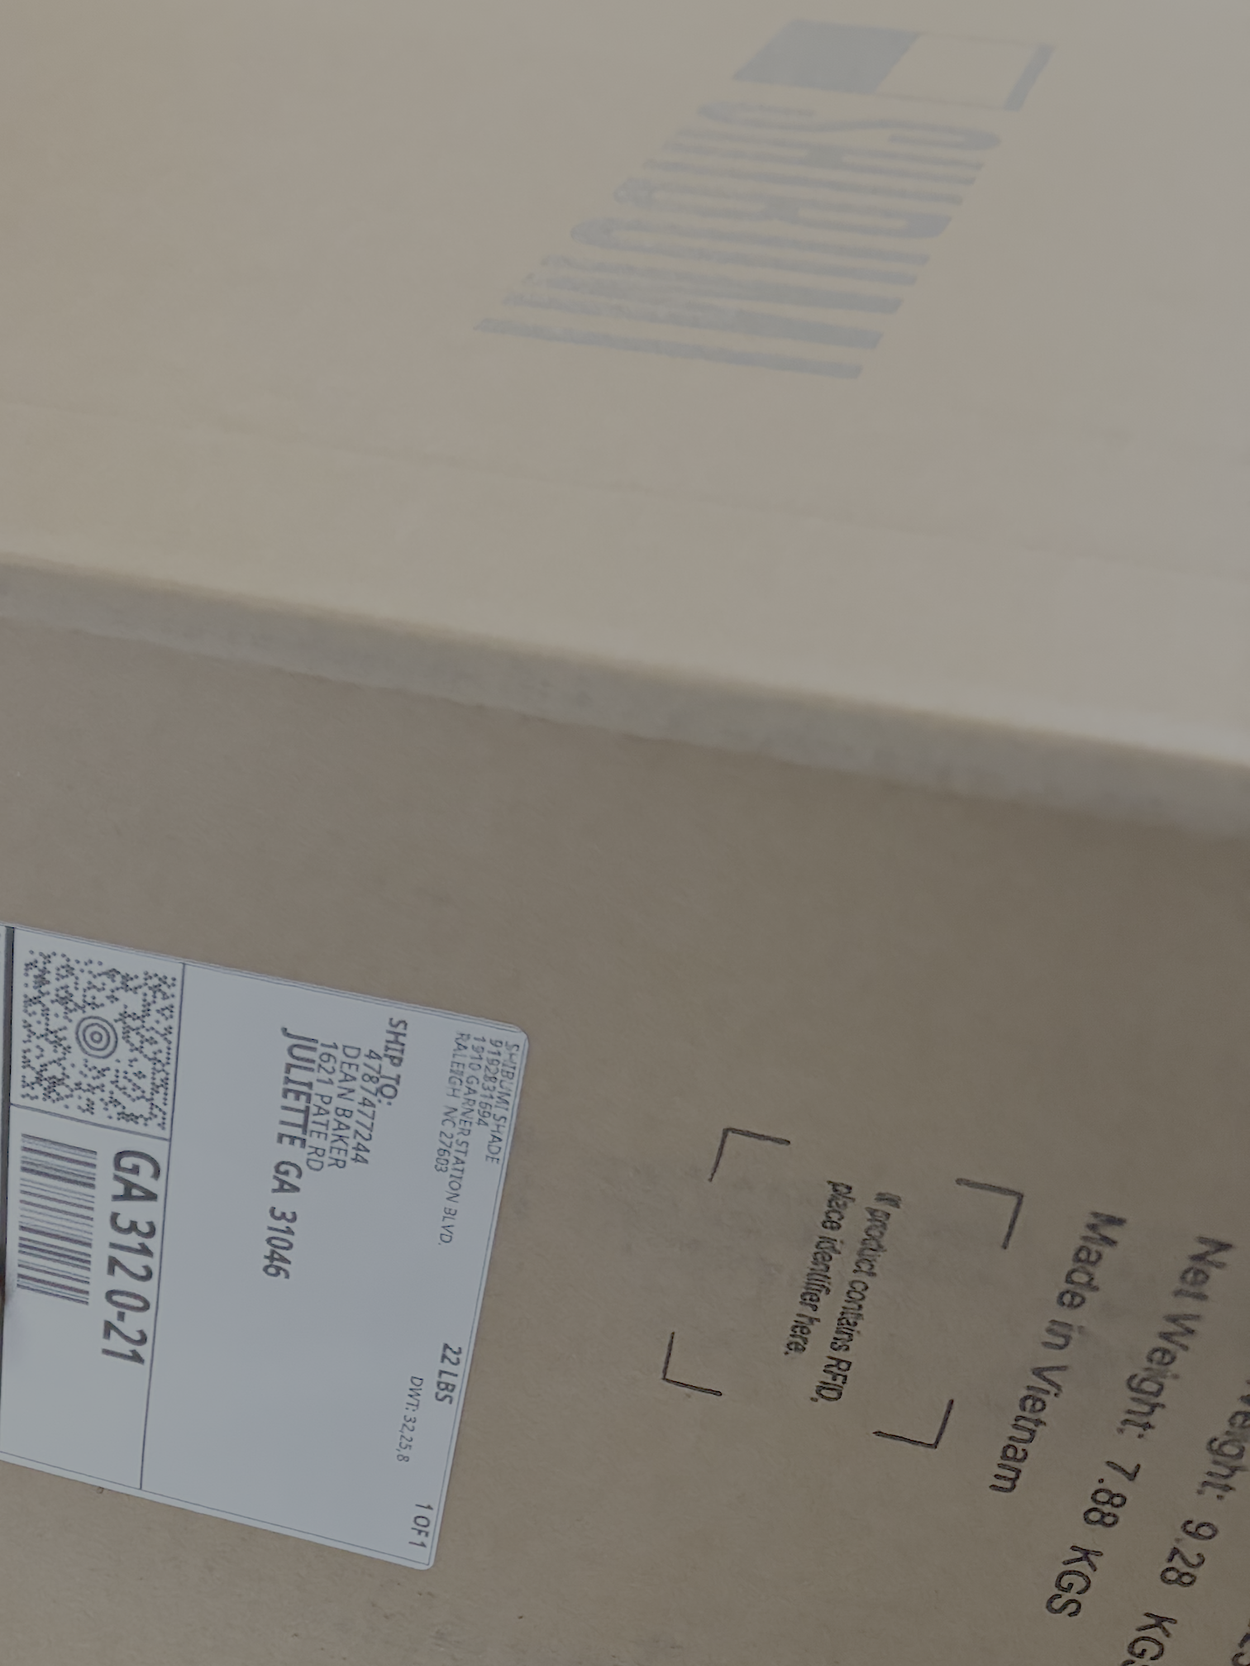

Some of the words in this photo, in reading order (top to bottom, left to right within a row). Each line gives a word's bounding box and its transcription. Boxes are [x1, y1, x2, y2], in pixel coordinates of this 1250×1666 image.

[473, 102, 1000, 379] SHIBUMI
[316, 1042, 339, 1085] 1621
[379, 1017, 408, 1067] SHIP
[446, 1032, 471, 1098] RALEIGH
[277, 1027, 319, 1149] JULIETTE
[337, 1045, 361, 1102] DEAN
[375, 1072, 401, 1106] TO:
[309, 1093, 333, 1141] PATE
[350, 1049, 382, 1164] 4787477244
[441, 1106, 458, 1128] NC
[455, 1075, 480, 1136] GARNER
[306, 1145, 326, 1172] RD
[328, 1107, 354, 1169] BAKER
[434, 1131, 454, 1173] 27603
[485, 1113, 507, 1164] SHADE
[112, 1150, 161, 1202] GA
[271, 1161, 303, 1193] GA
[446, 1137, 469, 1203] STATION
[438, 1207, 457, 1245] BLVD.
[821, 1180, 855, 1231] place
[107, 1211, 156, 1282] 312
[262, 1206, 297, 1279] 31046
[852, 1207, 891, 1277] product
[1056, 1212, 1127, 1310] Made
[1172, 1236, 1235, 1301] Net
[799, 1236, 844, 1312] identifier
[102, 1289, 151, 1365] 0-21
[784, 1313, 821, 1355] here.
[830, 1280, 869, 1351] contains
[1041, 1319, 1085, 1350] in
[440, 1343, 462, 1366] 22
[810, 1356, 852, 1402] RFID,
[1117, 1314, 1201, 1439] Weight:
[405, 1376, 424, 1412] DWT:
[435, 1369, 458, 1404] LBS
[396, 1415, 417, 1462] 32,25,8
[989, 1366, 1068, 1493] Vietnam
[1196, 1380, 1250, 1500] eight:
[1083, 1461, 1141, 1528] 7.88
[411, 1515, 430, 1537] OF
[1160, 1520, 1218, 1587] 9.28
[1046, 1545, 1103, 1617] KGS
